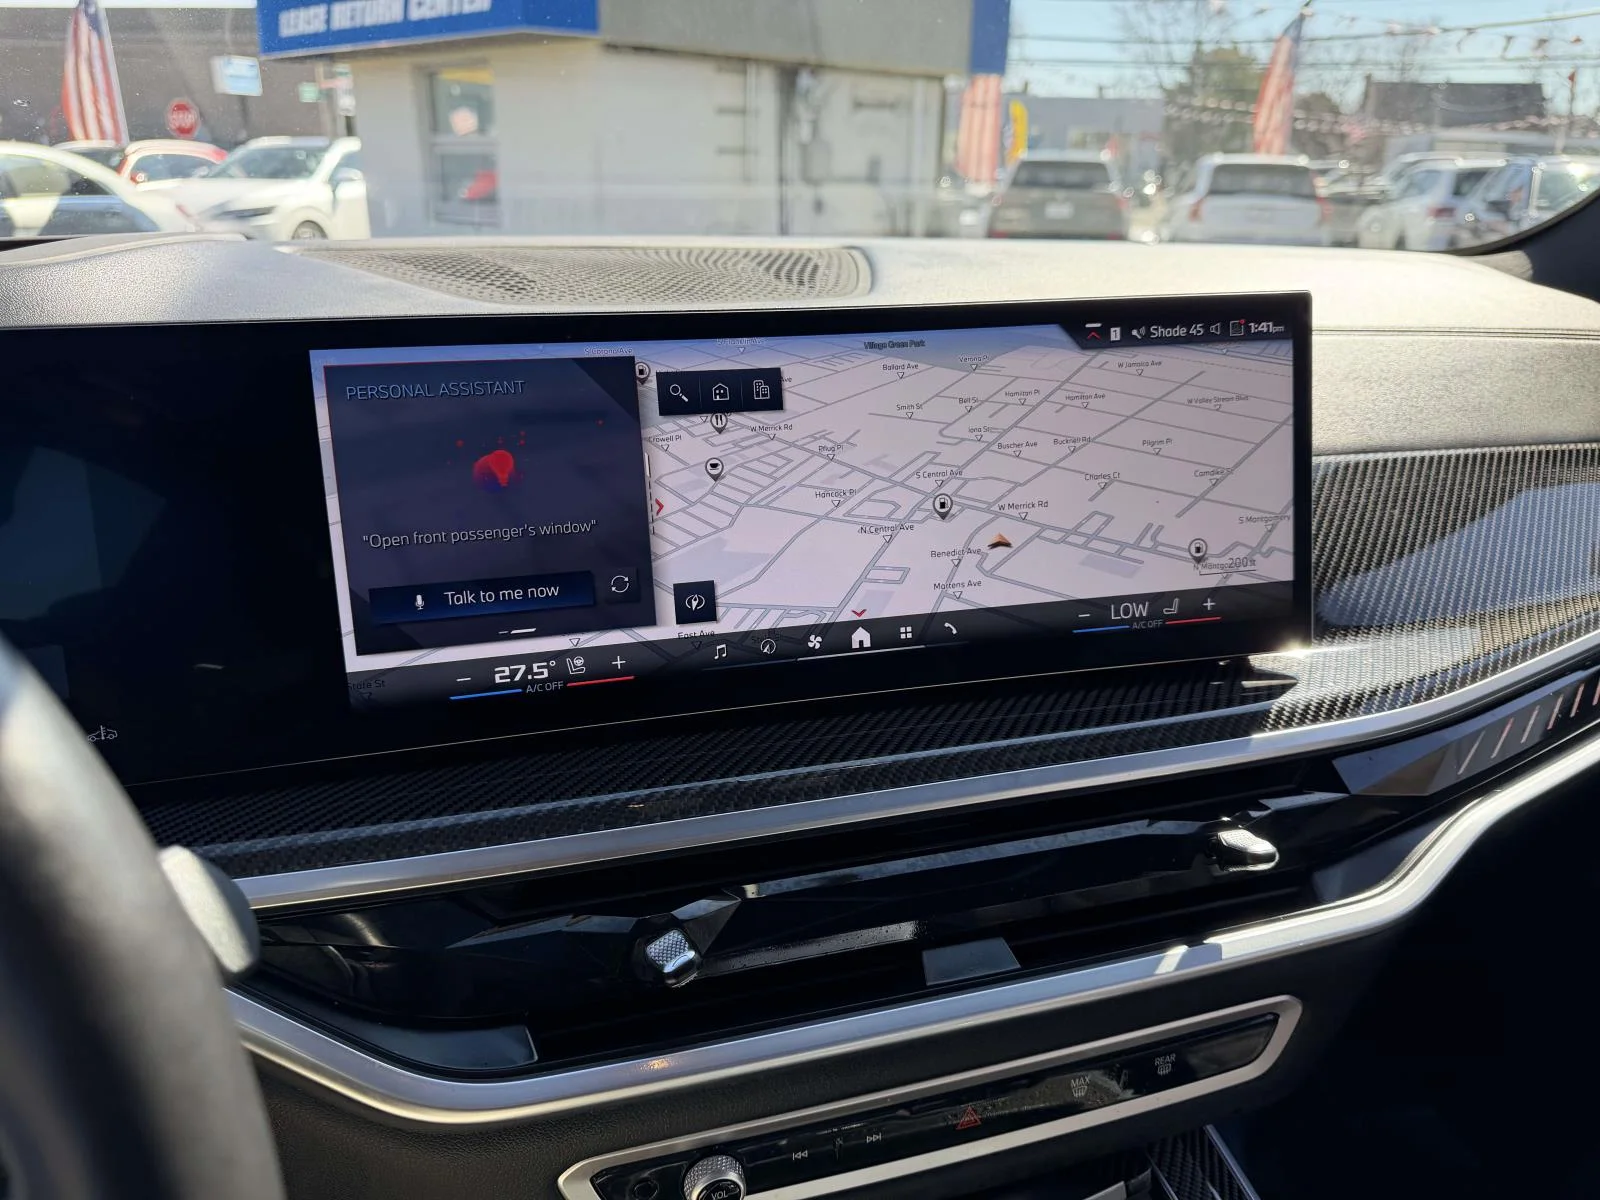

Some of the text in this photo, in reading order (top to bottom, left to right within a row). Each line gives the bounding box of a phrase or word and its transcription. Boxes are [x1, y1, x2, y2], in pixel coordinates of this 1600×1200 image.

[1150, 323, 1204, 338] Shade 45
[1249, 321, 1285, 334] 1:41pm
[863, 340, 925, 350] Village Green Park
[882, 363, 905, 371] Ballard
[1117, 359, 1162, 369] W Jamaica Ave
[346, 380, 525, 400] PERSONAL ASSISTANT
[1065, 392, 1105, 401] Hamilton Ave
[896, 402, 923, 411] Smith St
[757, 424, 782, 432] Merrick
[783, 423, 793, 431] Rd
[1082, 436, 1091, 444] Rd
[997, 442, 1024, 450] Buscher
[915, 469, 963, 479] S Central Ave
[1084, 471, 1121, 481] Charles Ct
[815, 488, 857, 499] Hancock Pl
[998, 500, 1049, 511] W Merrick Rd
[860, 523, 914, 534] N Central Ave
[362, 519, 597, 550] "Open front passenger's window"
[930, 547, 981, 559] Benedict Ave
[933, 580, 982, 591] Martens Ave
[444, 584, 559, 606] Talk to me now
[1111, 601, 1149, 620] LOW
[1132, 619, 1163, 630] A/C OFF
[526, 680, 564, 693] A/C OFF
[1155, 1053, 1176, 1067] REAR
[1070, 1075, 1090, 1088] MAX
[711, 1190, 729, 1200] VOL
